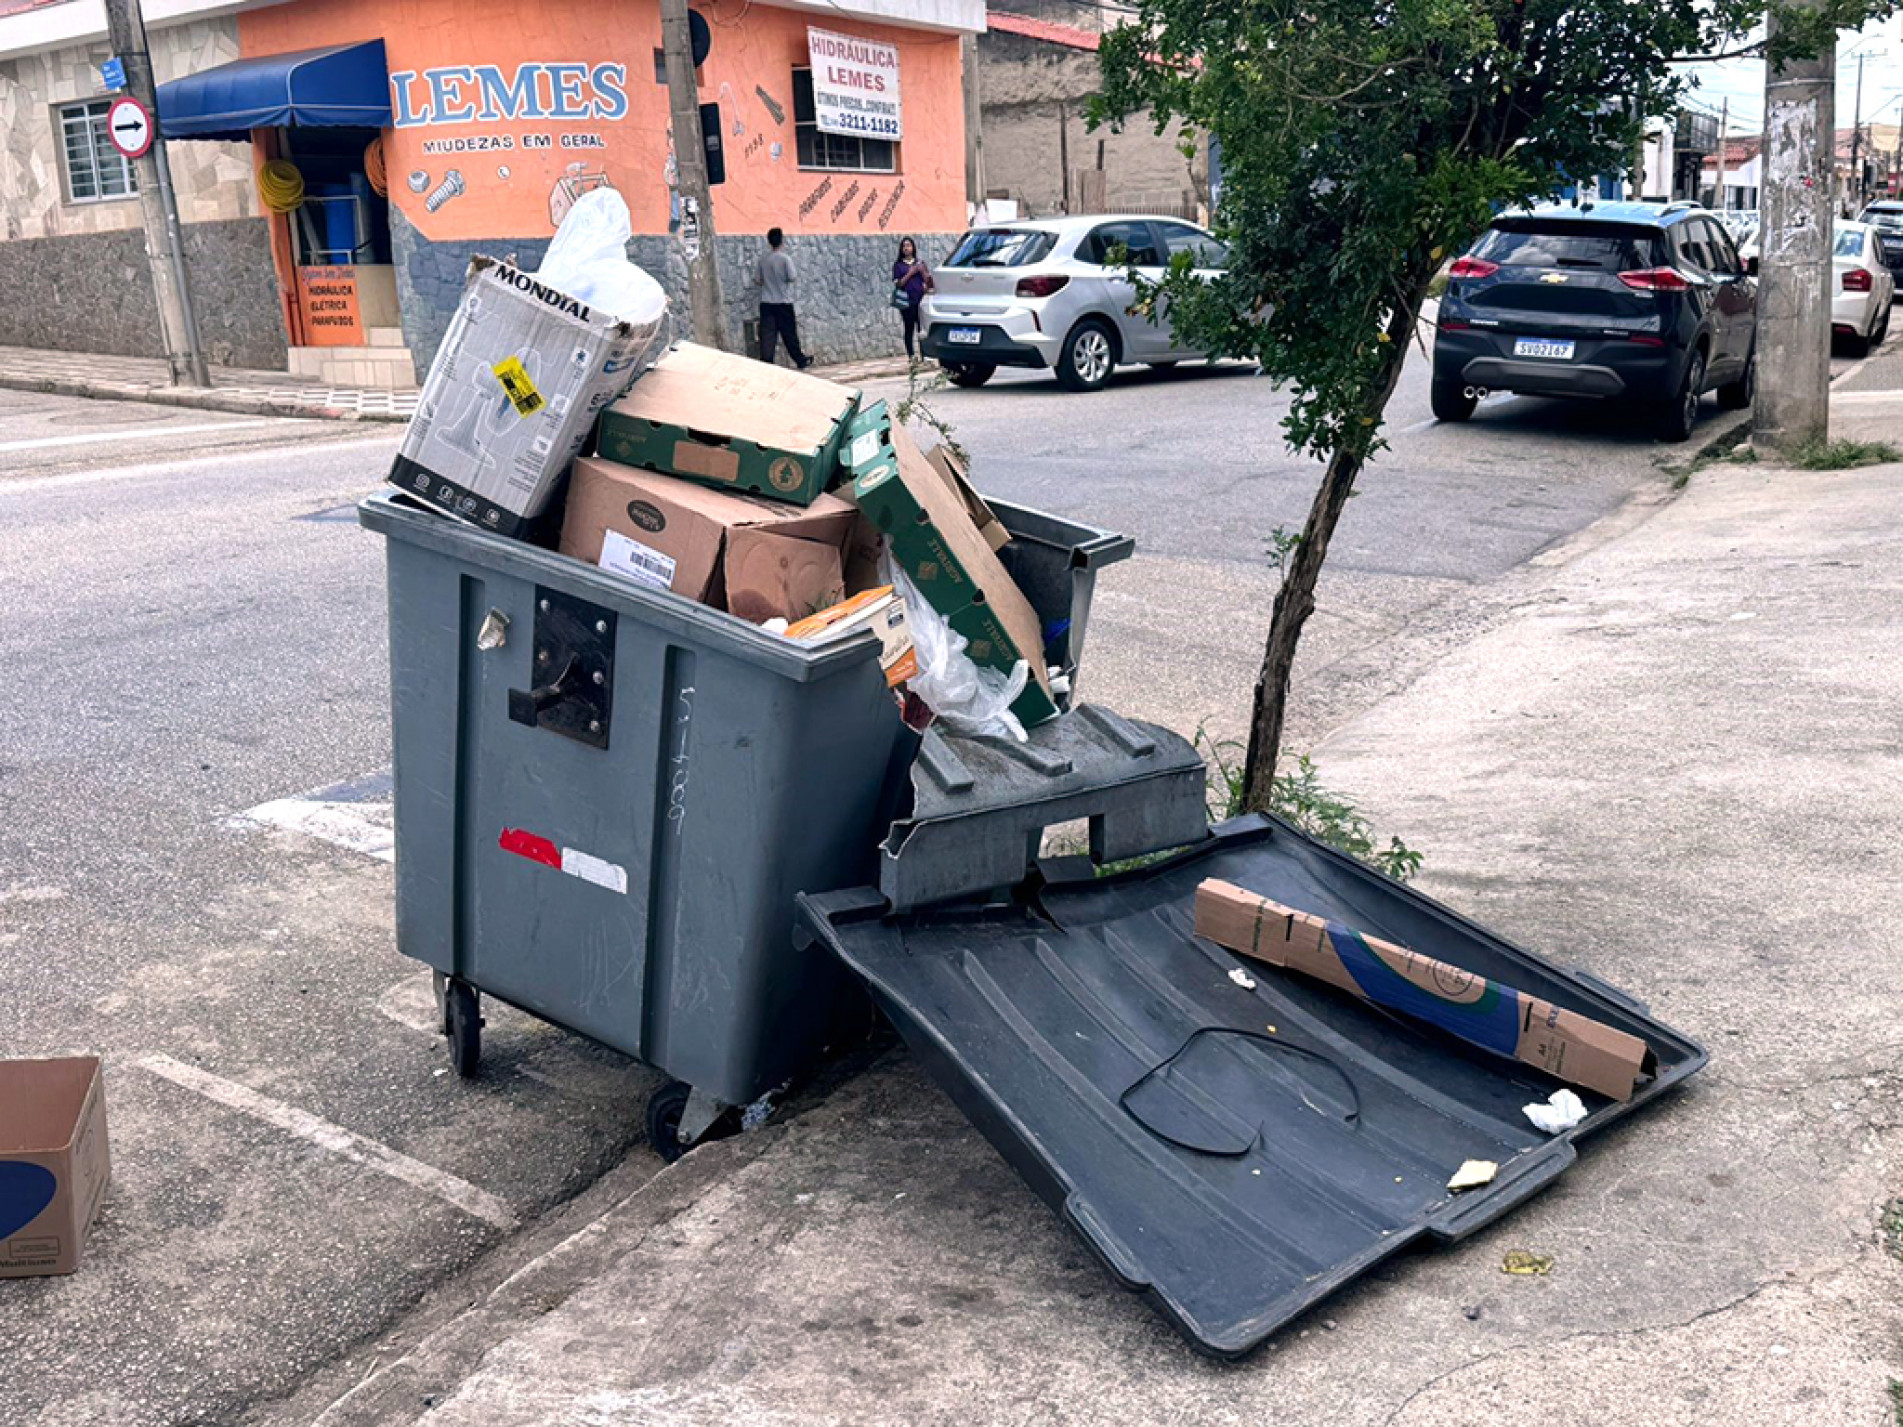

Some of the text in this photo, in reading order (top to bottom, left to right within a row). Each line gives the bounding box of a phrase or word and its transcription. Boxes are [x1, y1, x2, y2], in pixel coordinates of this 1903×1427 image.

[391, 63, 628, 128] LEMES
[827, 65, 886, 92] LEMES
[423, 134, 605, 155] MIUDEZAS EM GERAL
[494, 265, 590, 323] MONDIAL
